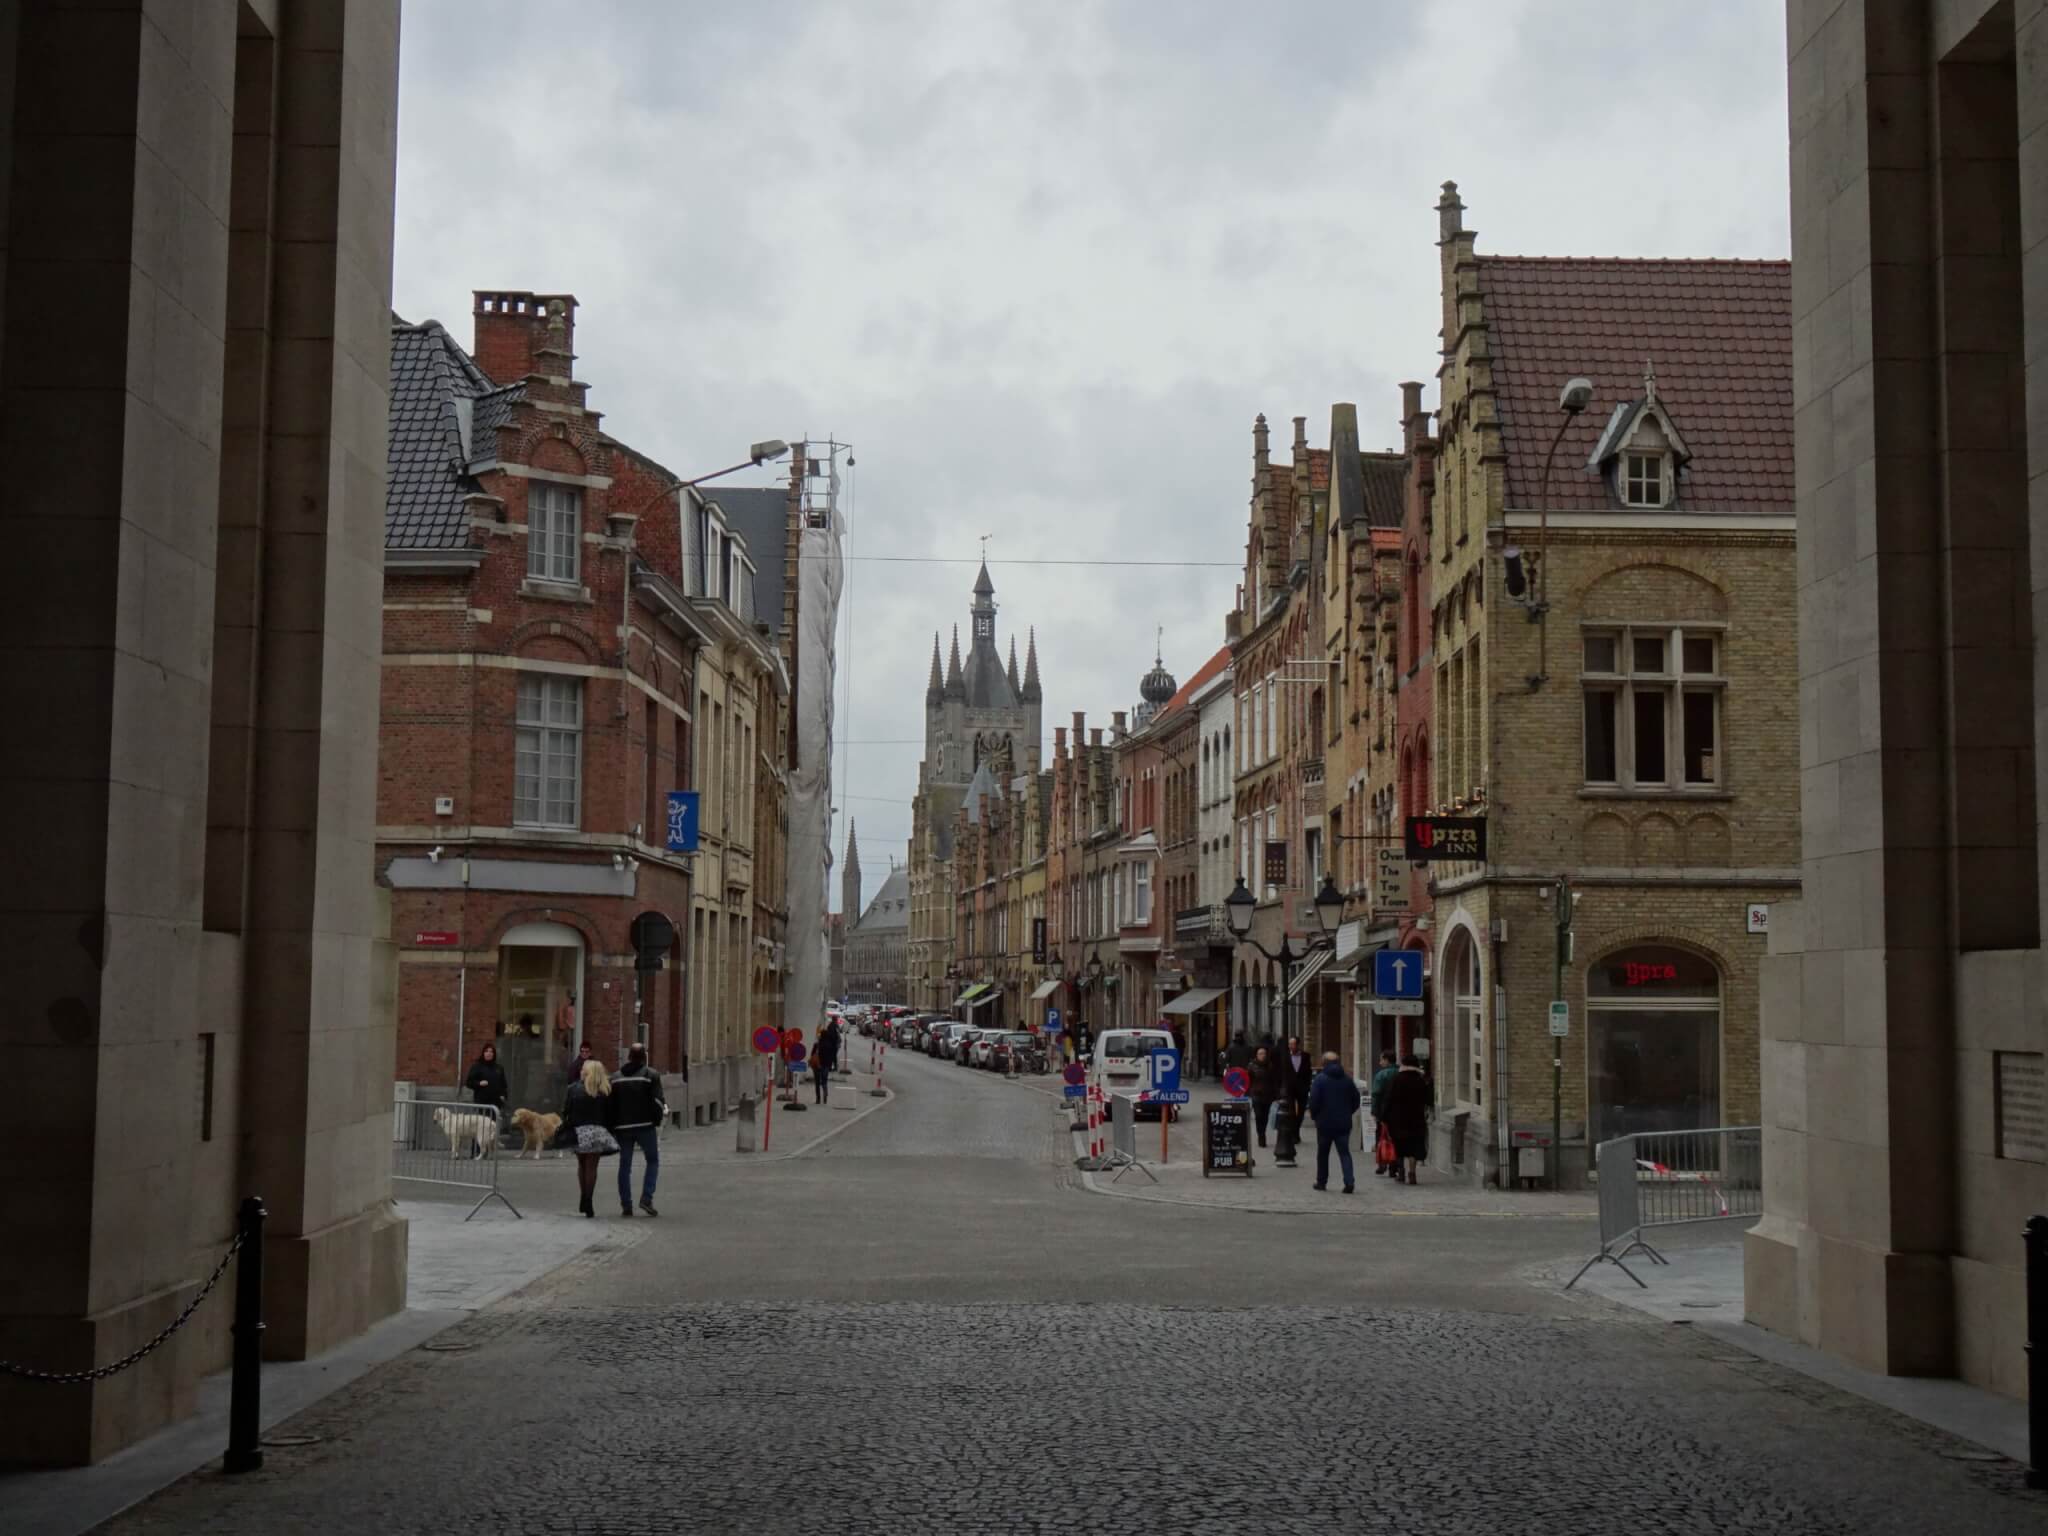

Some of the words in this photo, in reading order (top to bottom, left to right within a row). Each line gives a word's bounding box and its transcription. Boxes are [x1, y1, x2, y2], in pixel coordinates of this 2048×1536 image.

[1415, 822, 1477, 849] Ypra
[1447, 843, 1477, 853] INN
[1380, 849, 1403, 860] Over
[1380, 865, 1399, 876] The
[1380, 881, 1400, 892] Top
[1049, 1011, 1058, 1024] P
[1156, 1055, 1175, 1083] P
